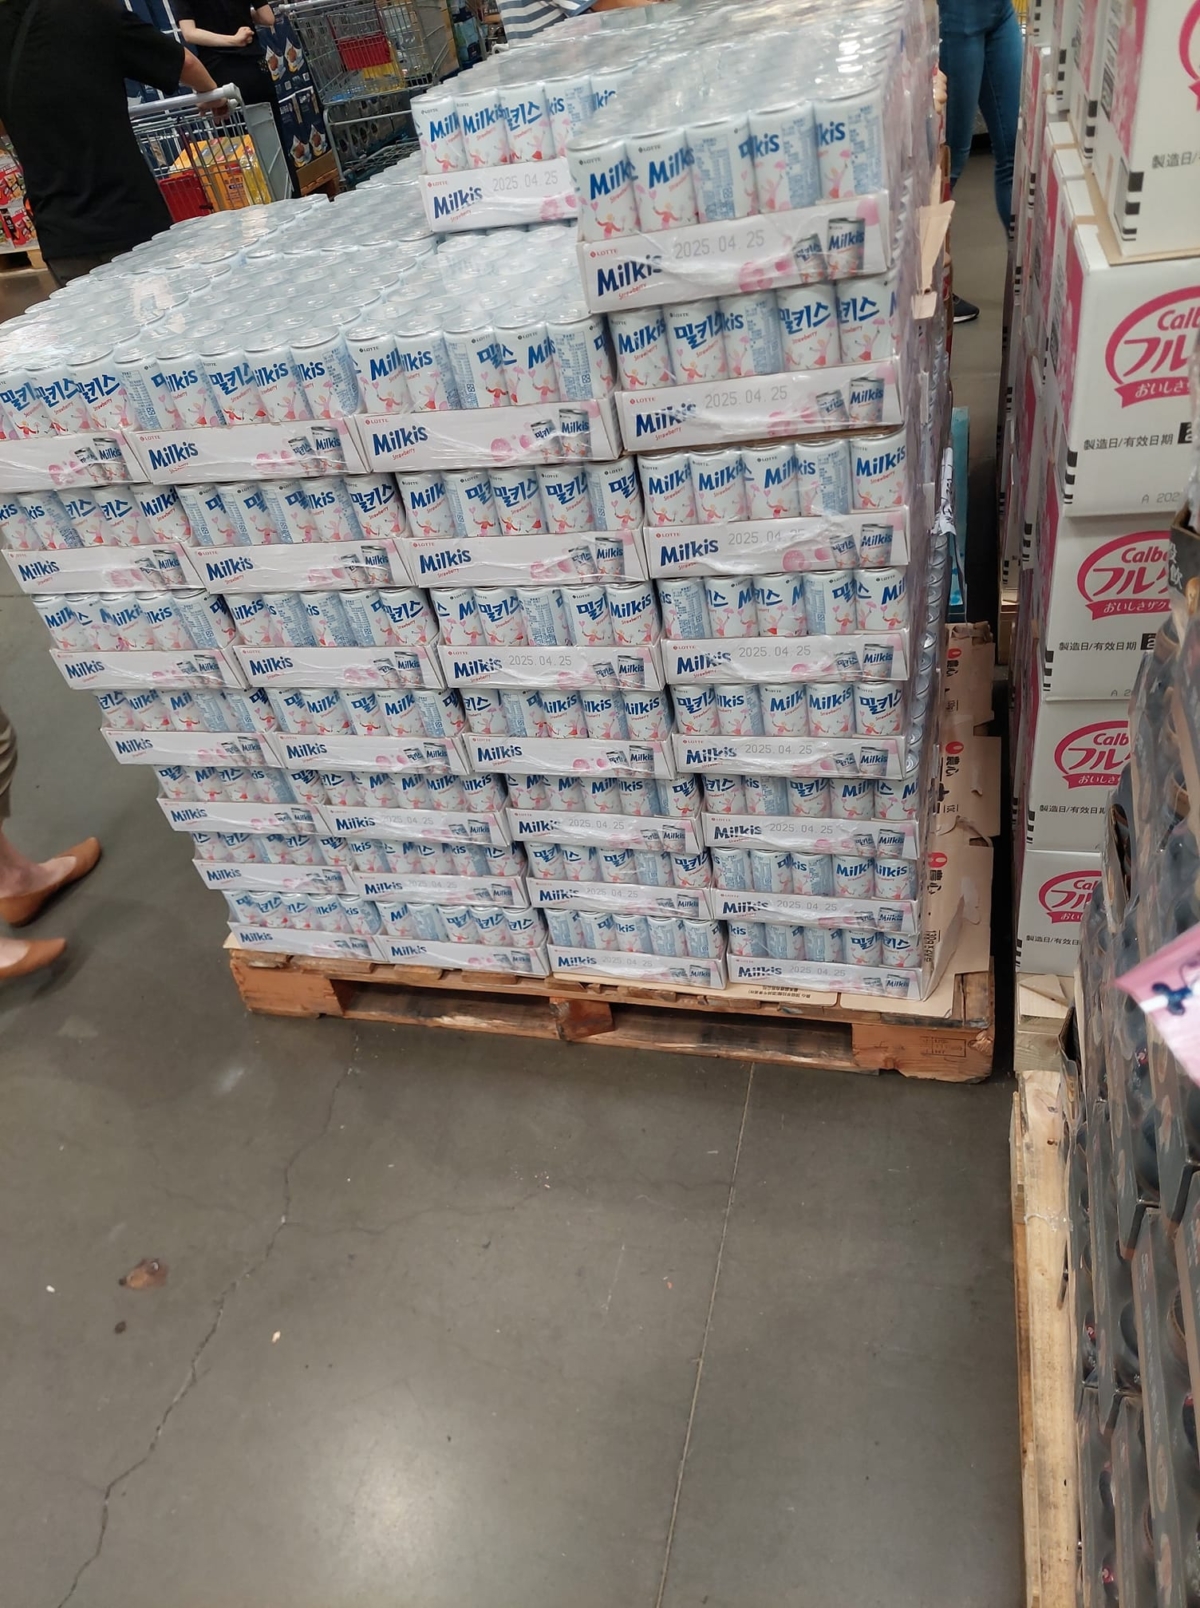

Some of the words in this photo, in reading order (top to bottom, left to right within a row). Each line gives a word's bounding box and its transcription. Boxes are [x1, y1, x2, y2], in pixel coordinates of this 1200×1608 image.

[1152, 151, 1200, 170] 製造日/
[493, 171, 558, 192] 2025.04.25
[434, 187, 483, 219] Milkis
[676, 230, 765, 259] 2025.04.25
[829, 231, 865, 250] Milkis
[597, 256, 663, 296] Milkis
[705, 385, 788, 409] 2025.04.25
[850, 388, 883, 404] Milkis
[636, 402, 697, 437] Milkis
[562, 421, 589, 435] Milkis
[655, 427, 682, 440] Strawberry
[316, 437, 340, 450] Milkis
[373, 425, 428, 456] Milkis
[149, 442, 198, 470] Milkis
[393, 448, 415, 460] Strawberry
[857, 446, 905, 477] Milkis
[1142, 494, 1150, 503] A
[861, 533, 892, 547] Milkis
[597, 548, 623, 560] Milkis
[661, 539, 718, 566] Milkis
[158, 559, 180, 569] Milkis
[365, 555, 388, 565] Milkis
[420, 549, 471, 574] Milkis
[18, 561, 59, 581] Milkis
[206, 556, 254, 581] Milkis
[739, 645, 811, 657] 2025.04.25
[1059, 641, 1137, 651] 製造日/有效日期
[508, 655, 572, 666] 2025.04.25
[677, 652, 731, 675] Milkis
[864, 652, 892, 663] Milkis
[65, 661, 105, 679] Milkis
[250, 656, 293, 676] Milkis
[398, 660, 420, 670] Milkis
[454, 658, 502, 678] Milkis
[619, 663, 643, 674] Milkis
[1111, 689, 1118, 697] A
[116, 739, 152, 754] Milkis
[286, 743, 327, 759] Milkis
[745, 745, 812, 754] 2025.04.25
[427, 750, 447, 758] Milkis
[478, 745, 522, 762] Milkis
[631, 754, 653, 762] Milkis
[686, 747, 737, 764] Milkis
[861, 755, 887, 764] Milkis
[1068, 748, 1131, 770] フル
[1078, 774, 1120, 785] おいしさ
[171, 809, 208, 822] Milkis
[336, 817, 375, 831] Milkis
[569, 819, 624, 829] 2025.04.25
[769, 824, 833, 834] 2025.04.25
[714, 826, 762, 839] Milkis
[879, 836, 904, 844] Milkis
[207, 869, 241, 881] Milkis
[365, 881, 402, 895] Milkis
[723, 901, 768, 913] Milkis
[777, 900, 837, 910] 2025.04.25
[240, 933, 273, 942] Milkis
[392, 946, 427, 956] Milkis
[558, 957, 596, 966] Milkis
[738, 966, 782, 977] Milkis
